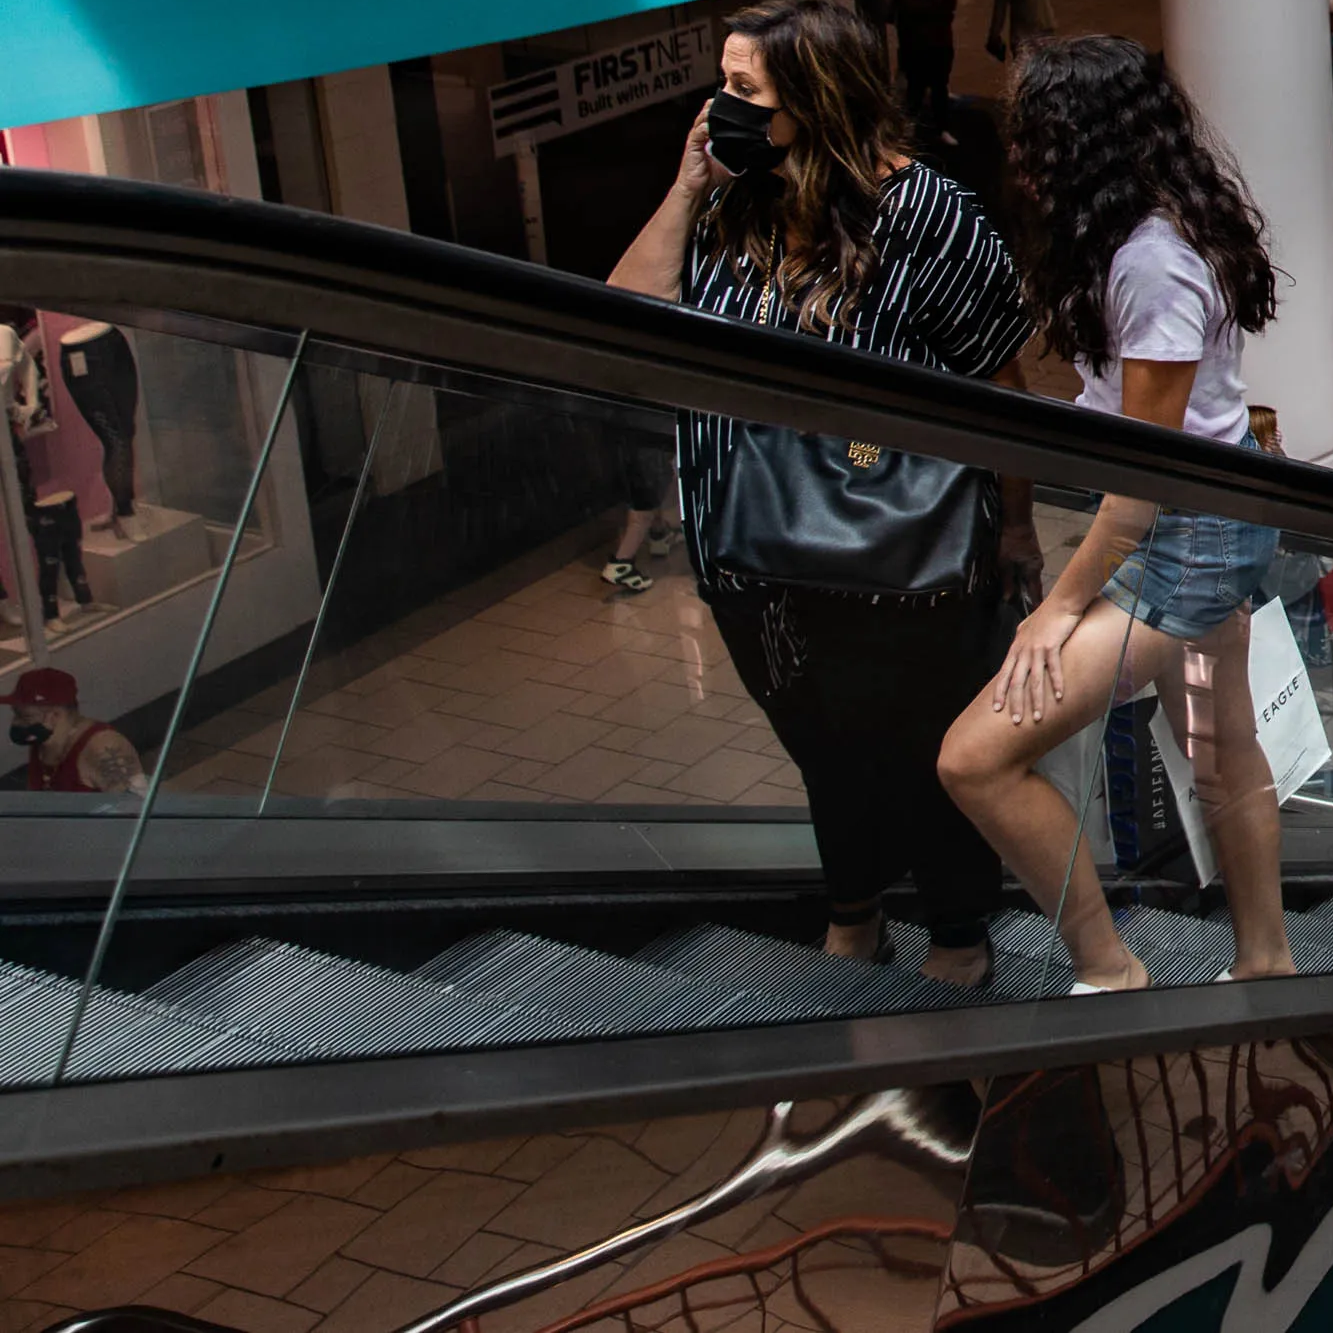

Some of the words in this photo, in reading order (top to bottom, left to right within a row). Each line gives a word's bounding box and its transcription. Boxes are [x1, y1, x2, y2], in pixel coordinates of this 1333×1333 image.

[578, 94, 613, 118] Built
[616, 80, 649, 105] with
[652, 67, 692, 94] AT&T
[1262, 676, 1300, 723] EAGLE
